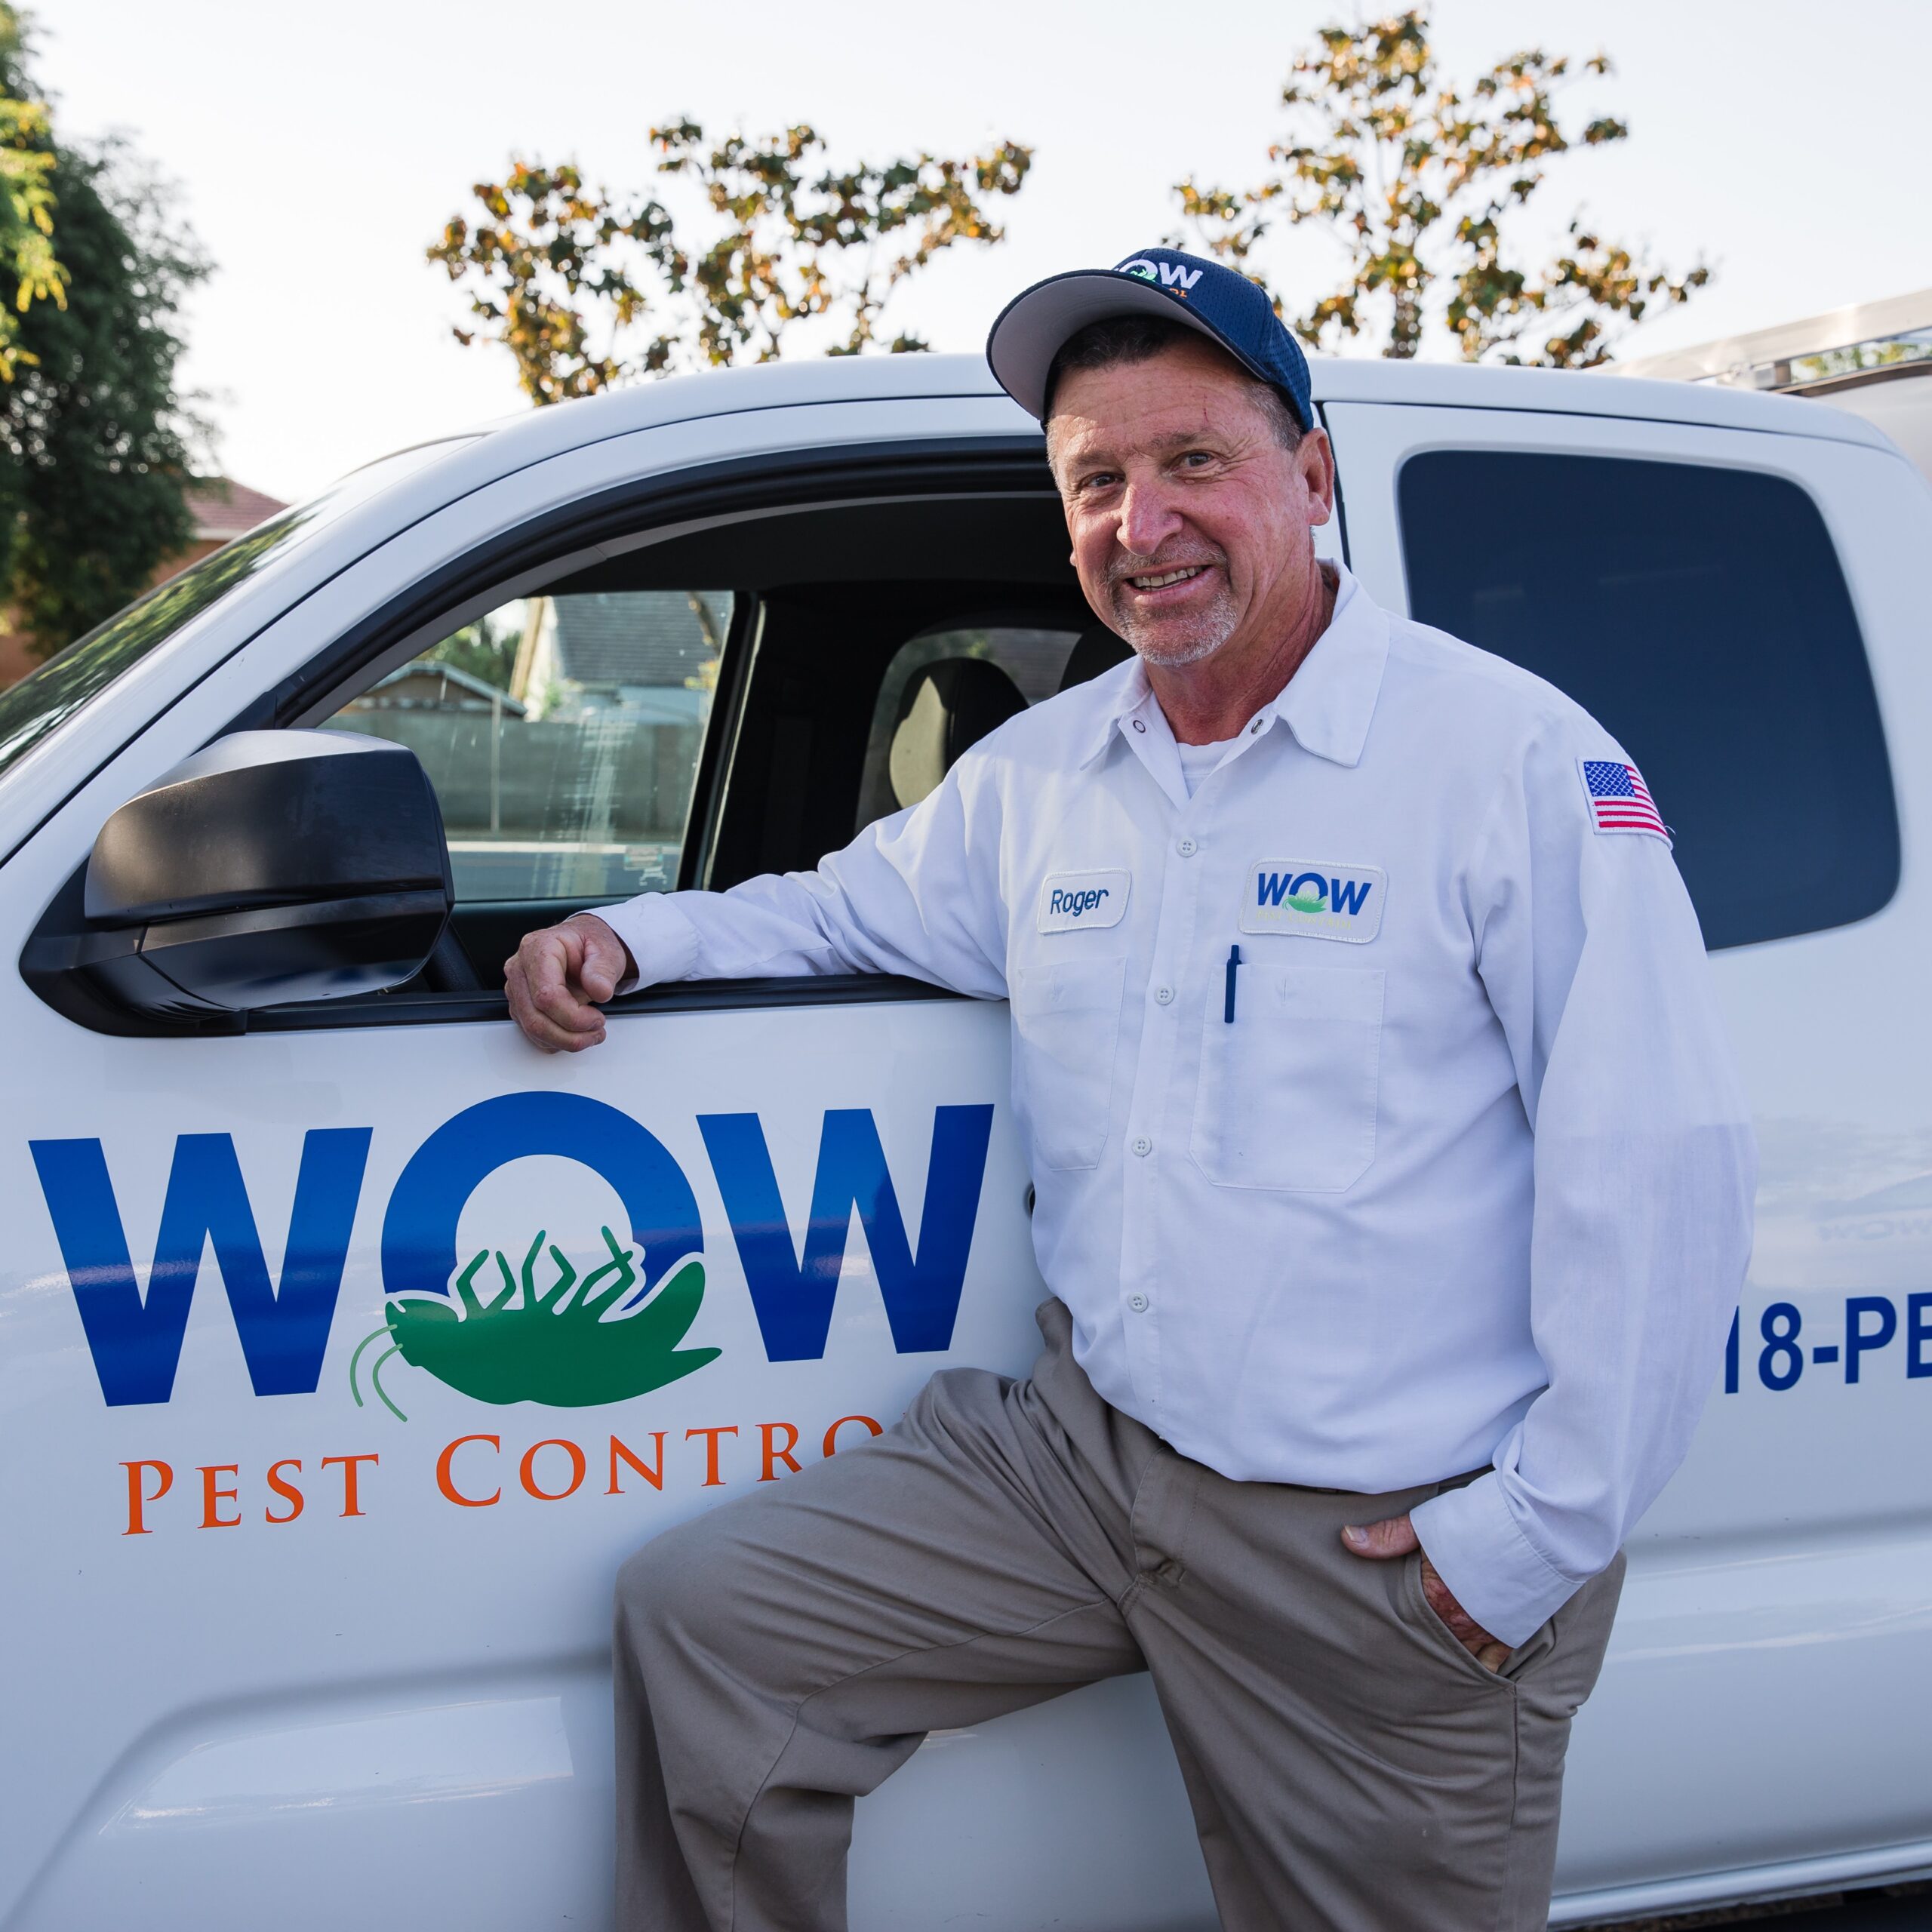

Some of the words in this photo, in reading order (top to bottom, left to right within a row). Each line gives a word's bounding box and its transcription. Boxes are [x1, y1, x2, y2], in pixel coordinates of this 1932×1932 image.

[1114, 259, 1203, 289] OW
[1050, 889, 1109, 917] Roger
[1258, 872, 1372, 915] WOW
[28, 1091, 995, 1407] WOW
[118, 1454, 379, 1536] PEST
[436, 1414, 883, 1507] CONTRO
